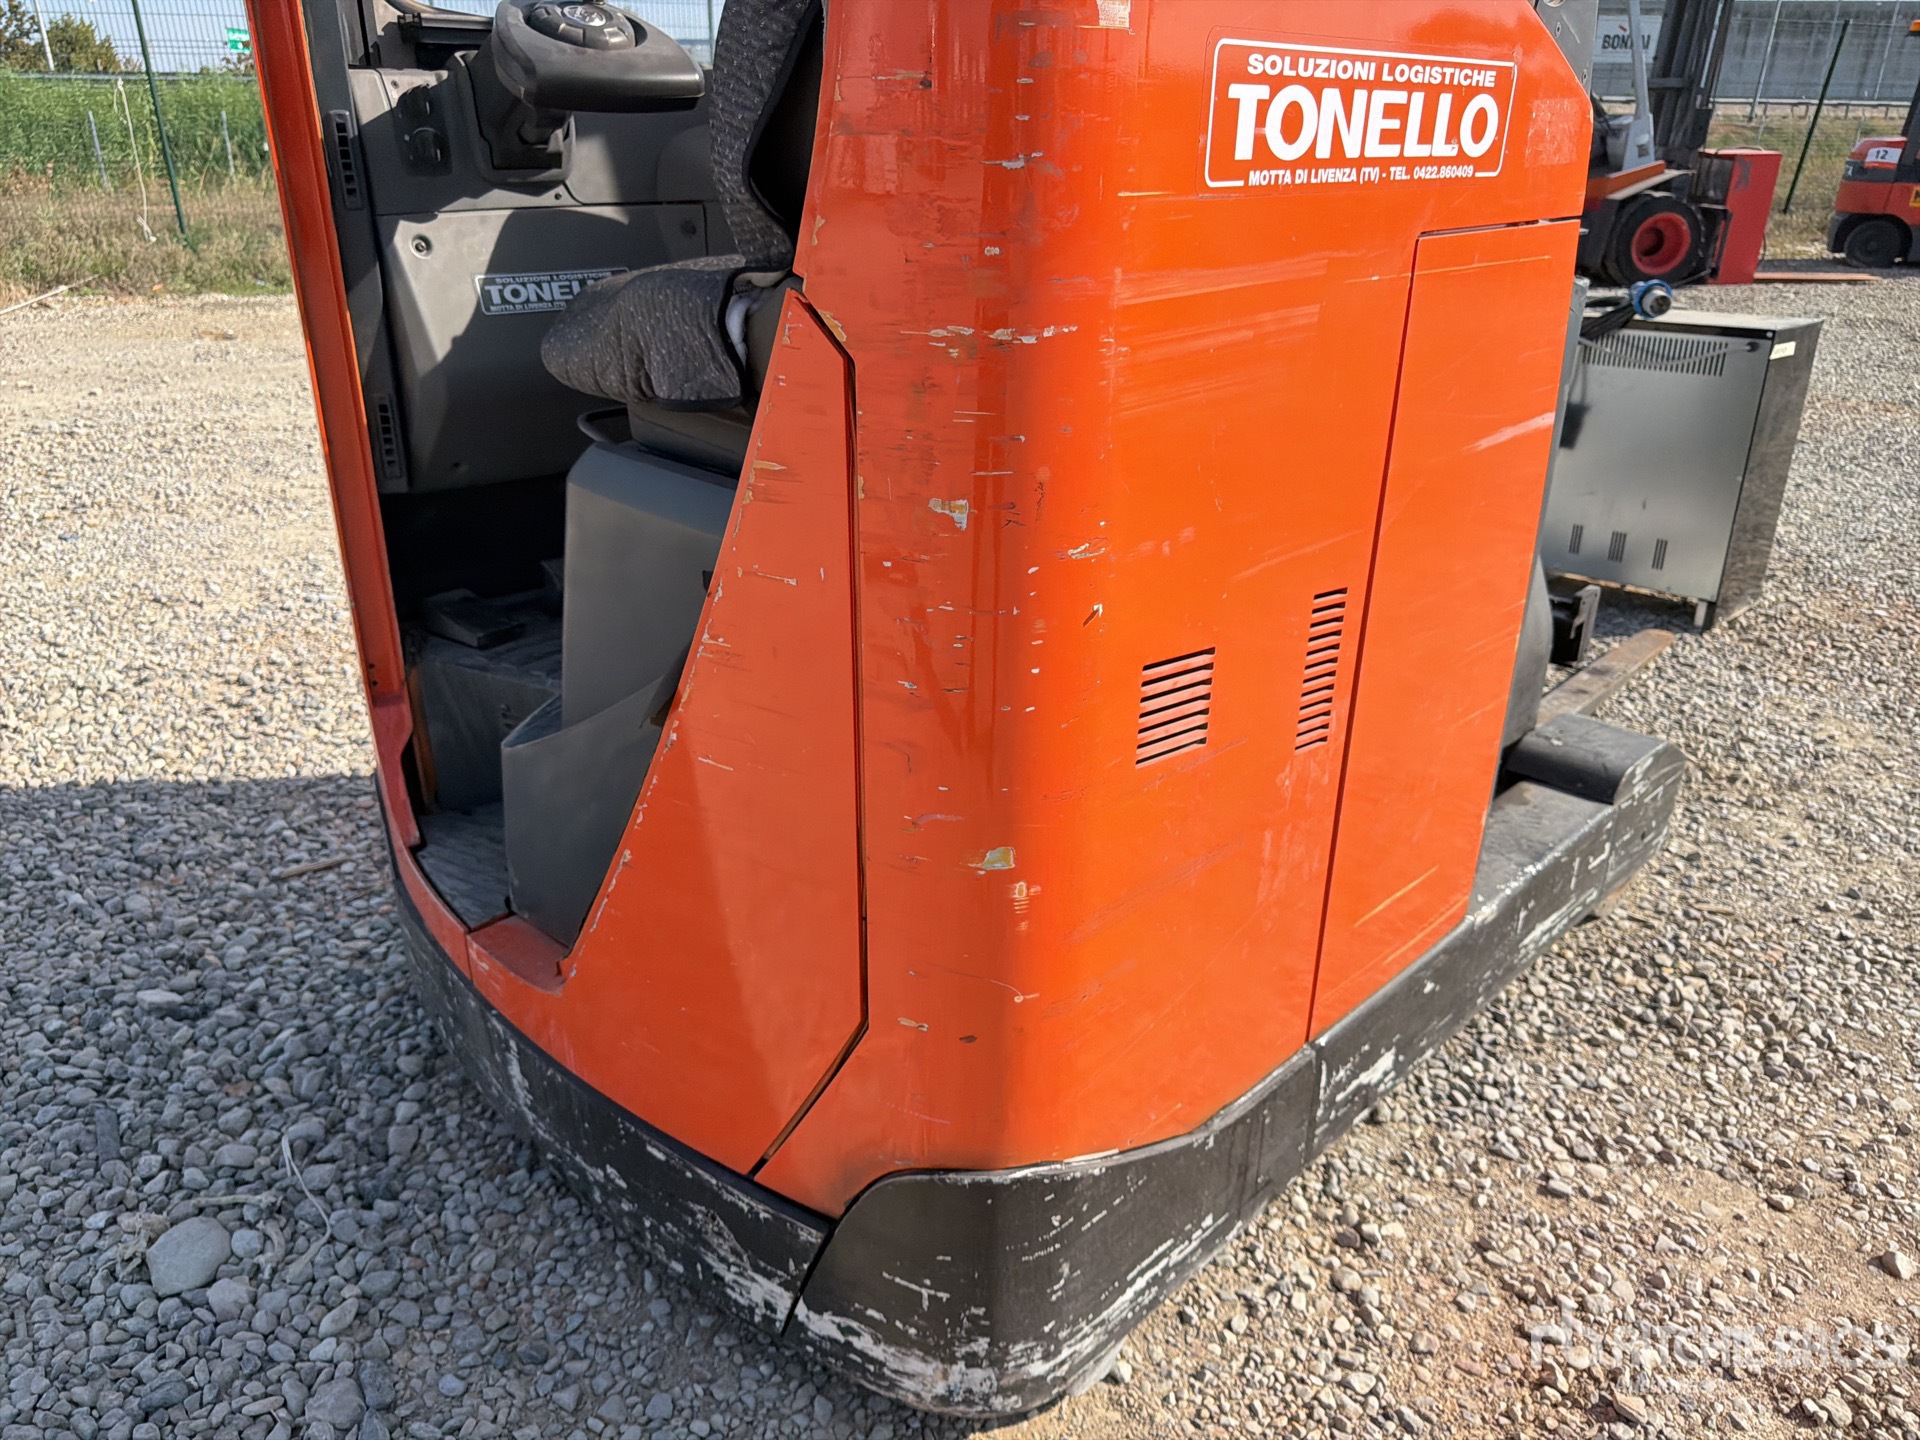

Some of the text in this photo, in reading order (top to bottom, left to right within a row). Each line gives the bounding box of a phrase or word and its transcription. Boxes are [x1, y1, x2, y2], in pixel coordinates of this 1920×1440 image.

[1247, 53, 1497, 87] SOLUZIONI LOGISTICHE
[1228, 83, 1499, 161] TONELLO
[1875, 149, 1889, 160] 12
[1248, 169, 1292, 186] MOTTA
[1295, 168, 1307, 184] DI
[1311, 167, 1357, 184] LIVENZA
[1359, 166, 1380, 185] (TV)
[1389, 165, 1411, 181] TEL.
[1413, 164, 1474, 180] 0422.860409
[484, 279, 596, 305] TONEL
[495, 275, 551, 285] SOLUZIONI
